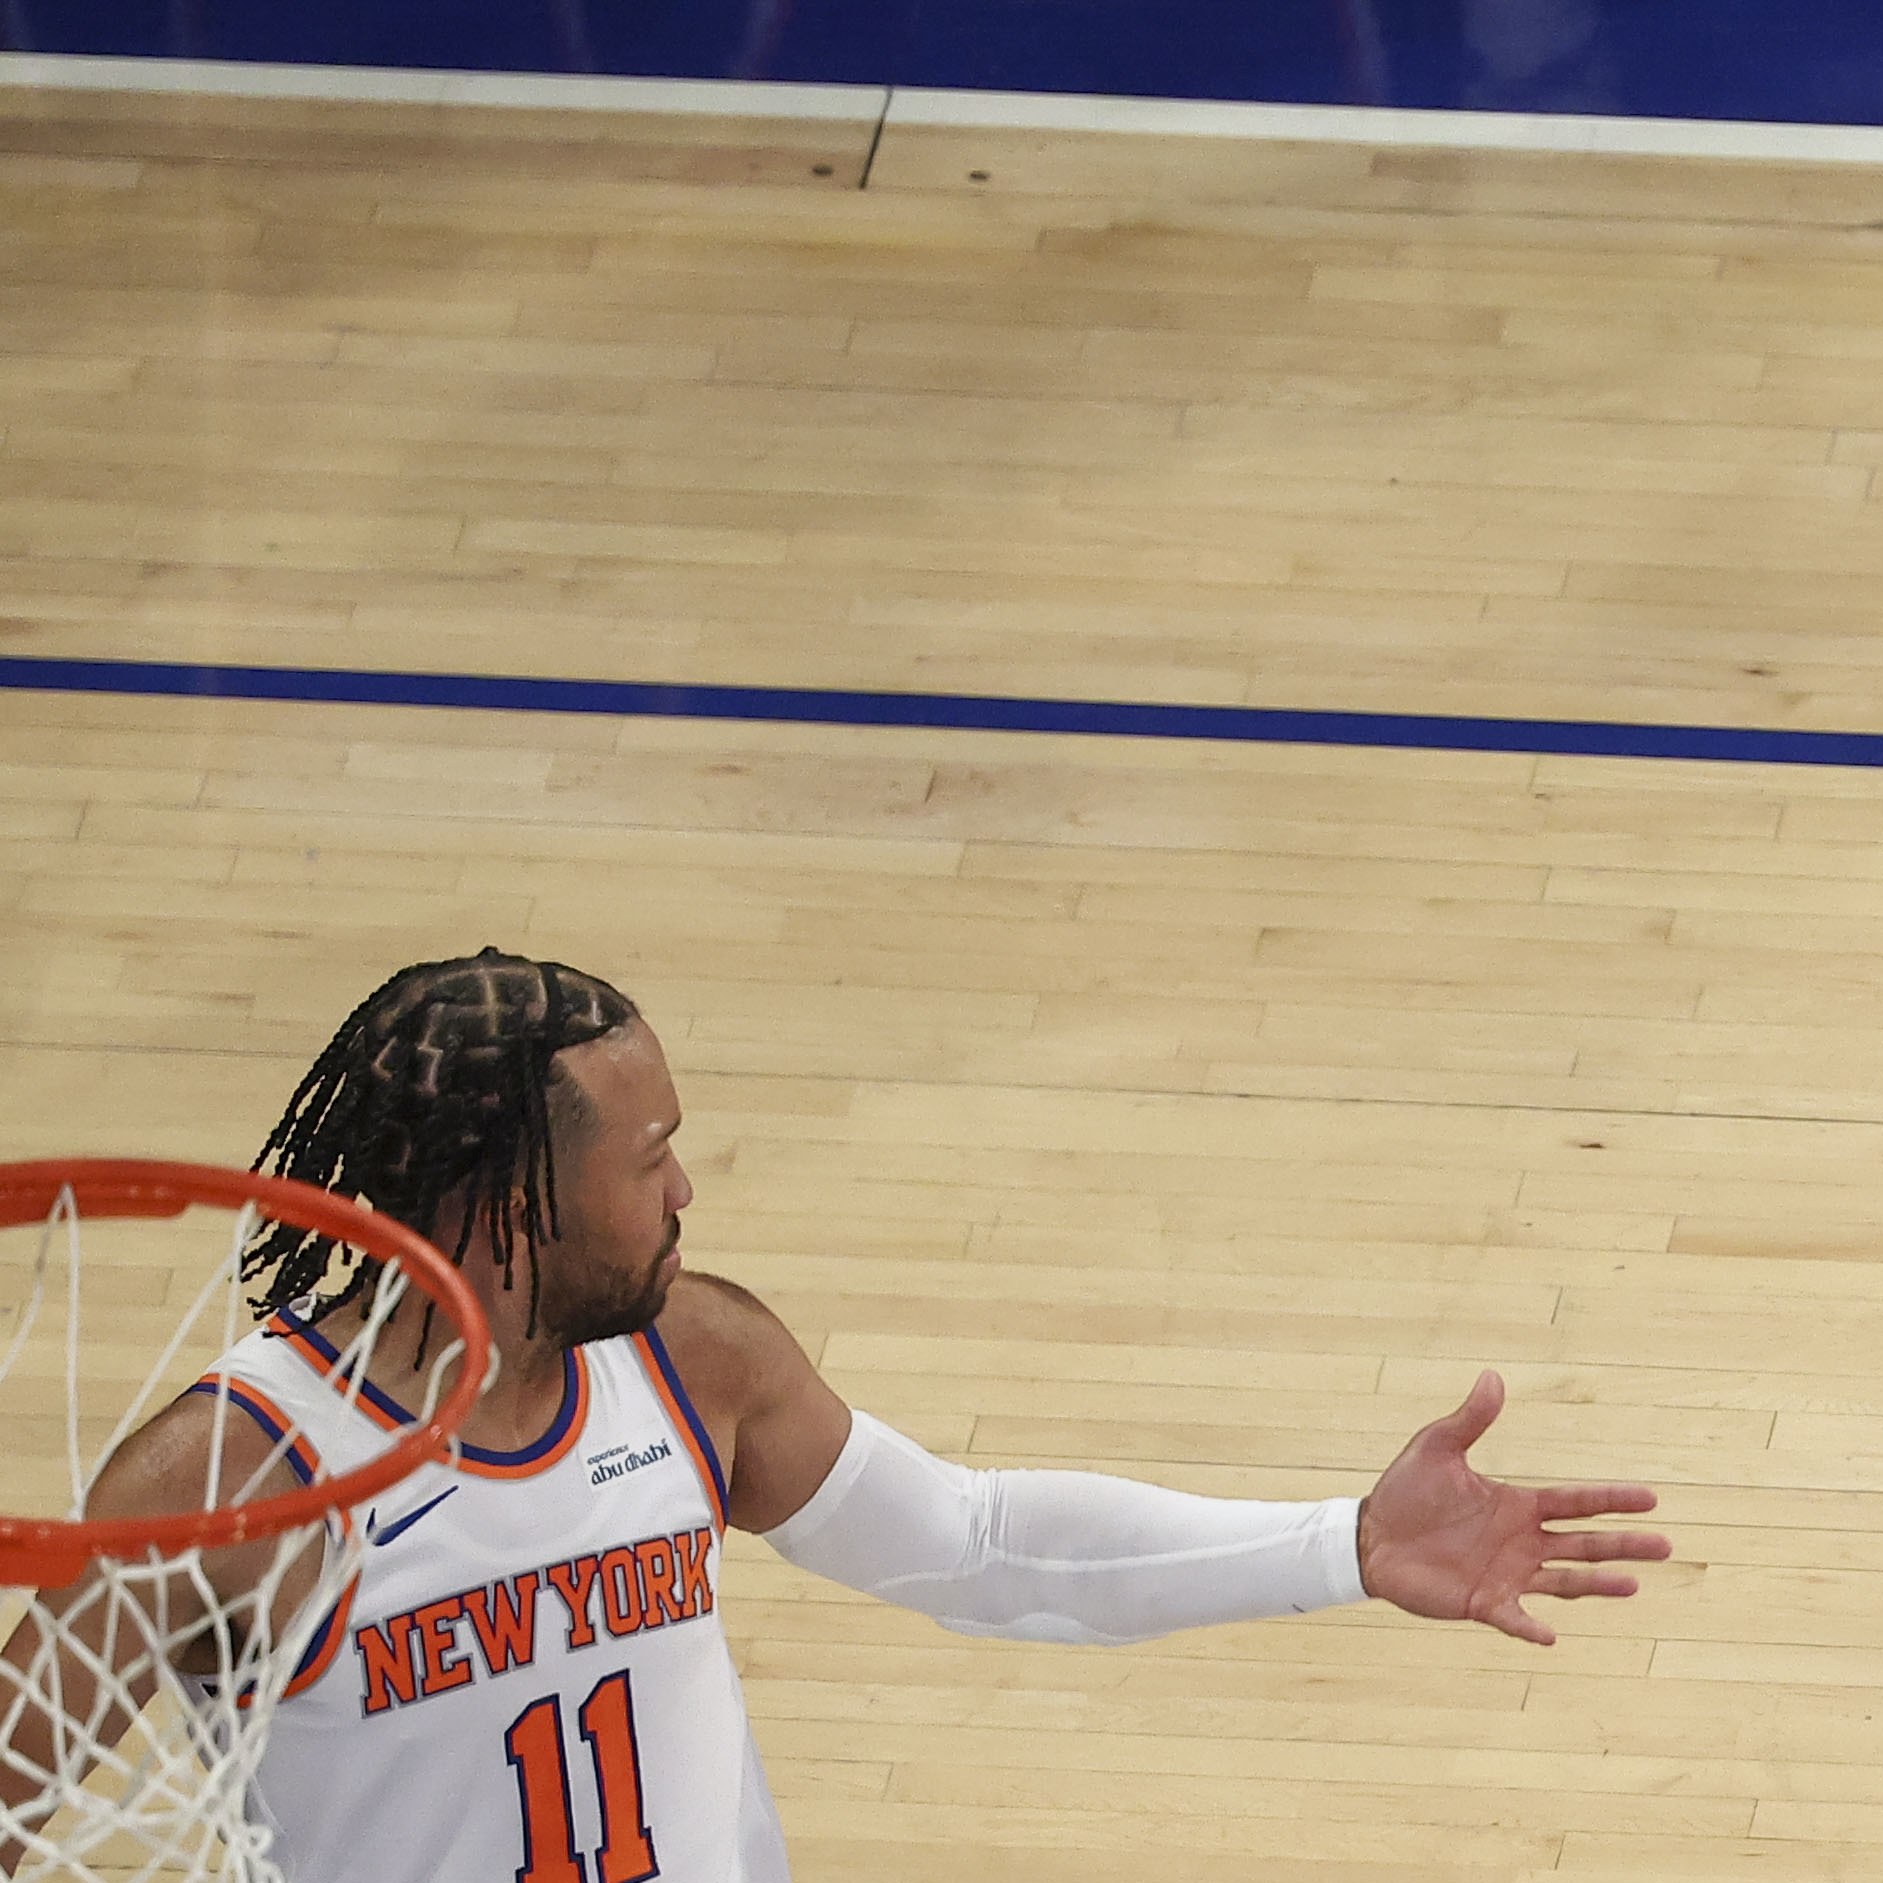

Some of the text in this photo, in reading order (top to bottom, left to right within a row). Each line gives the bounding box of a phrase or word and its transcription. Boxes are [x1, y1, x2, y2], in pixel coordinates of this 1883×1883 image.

[591, 1438, 672, 1485] abu dhabi
[355, 1526, 715, 1719] NEW YORK
